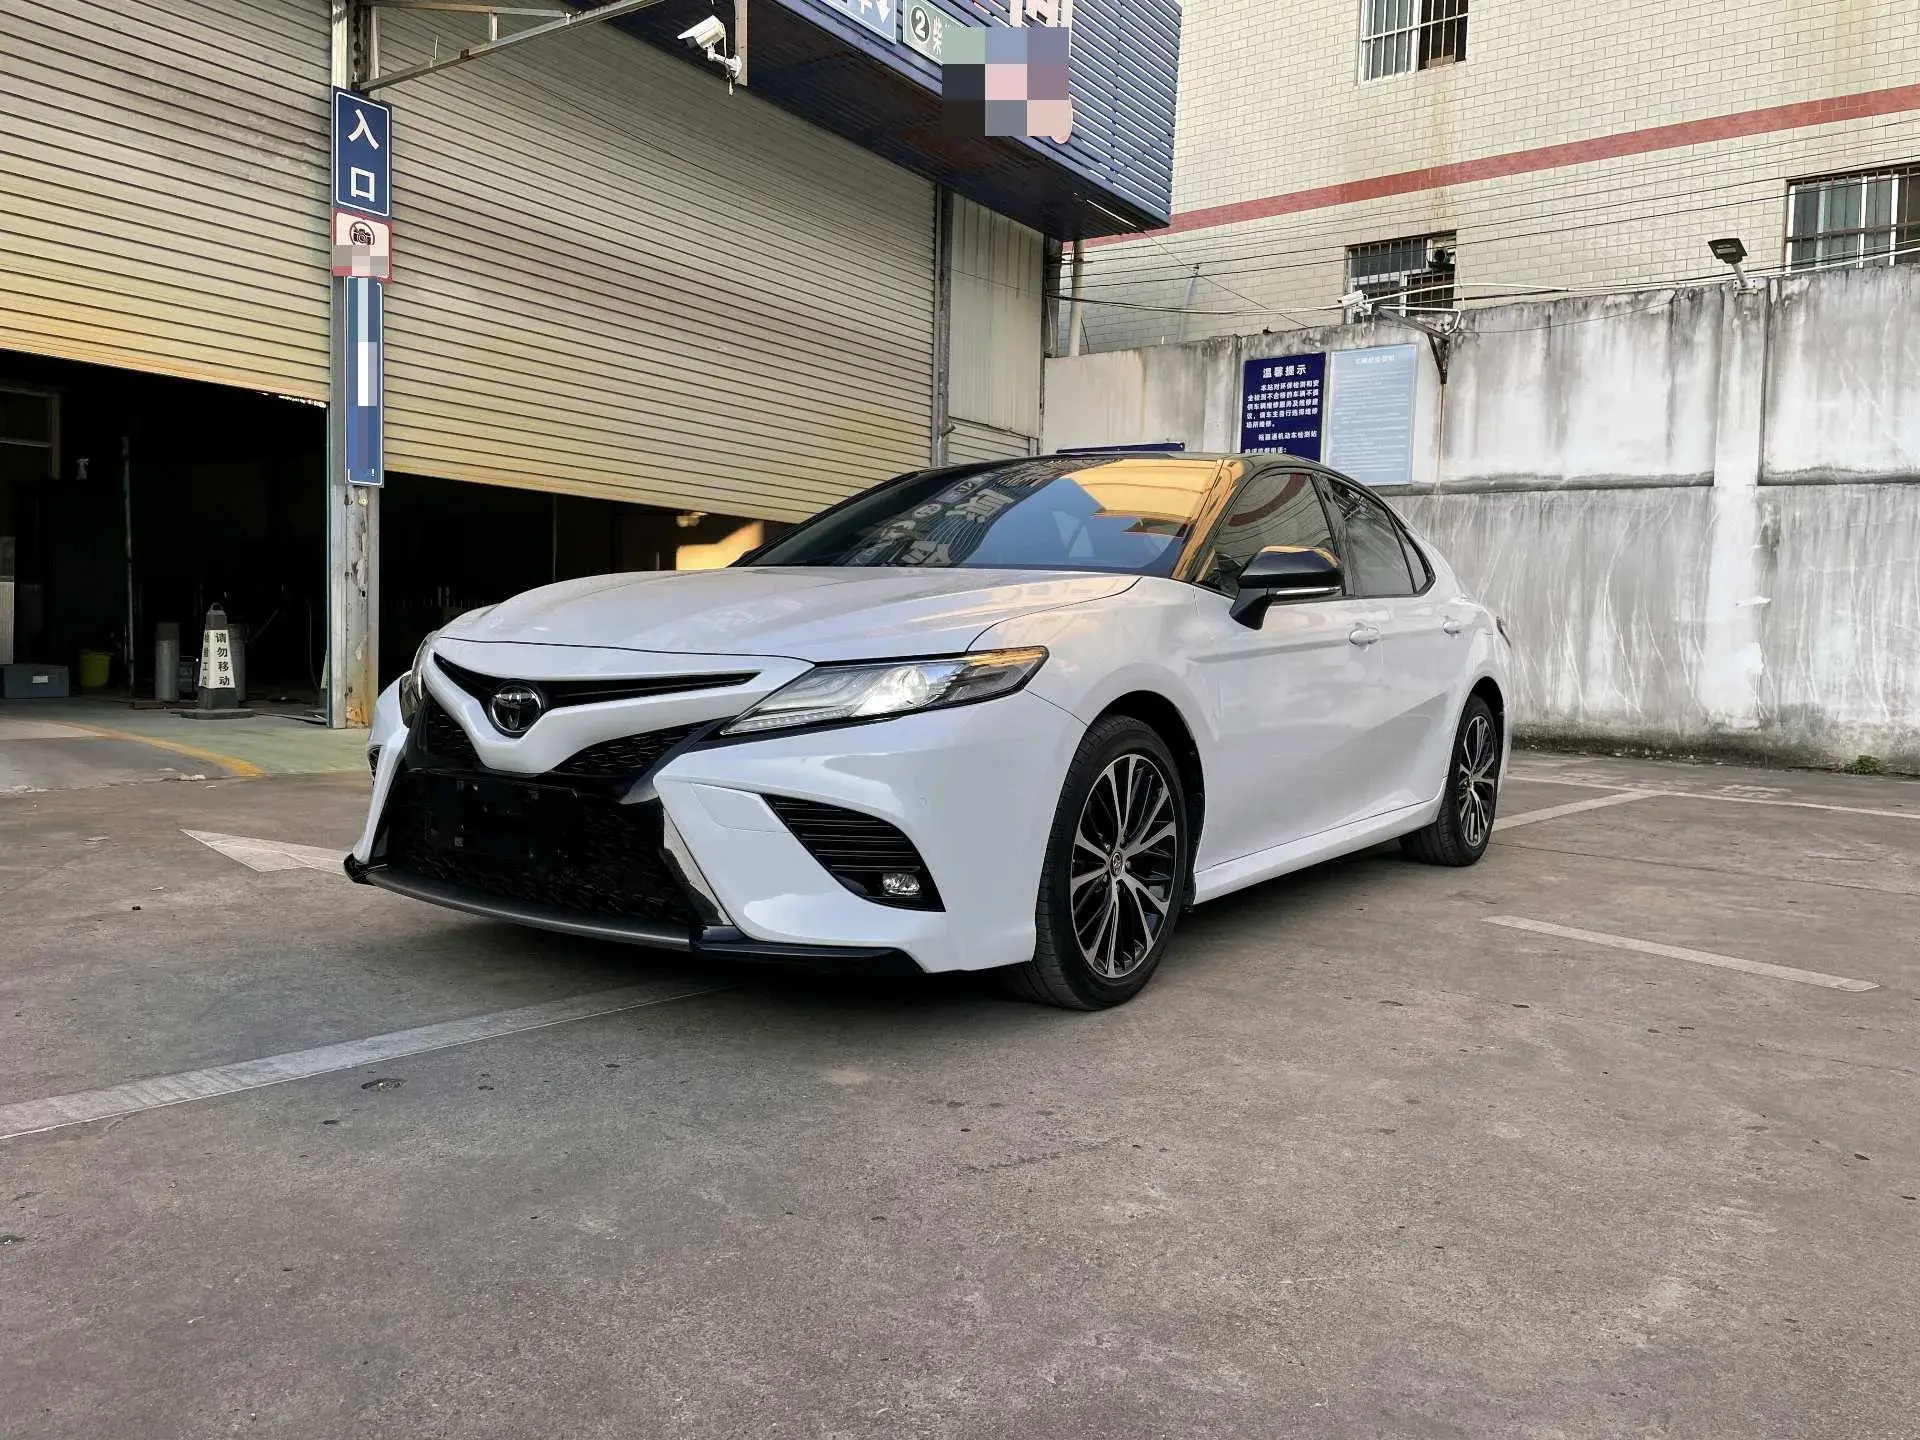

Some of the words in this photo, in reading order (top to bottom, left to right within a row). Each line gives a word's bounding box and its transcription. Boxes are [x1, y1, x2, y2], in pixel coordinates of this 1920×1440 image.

[348, 109, 380, 202] 入口
[1260, 380, 1319, 391] 本站对环保检测和安
[1262, 364, 1307, 379] 温馨提示
[216, 632, 230, 686] 请勿移动
